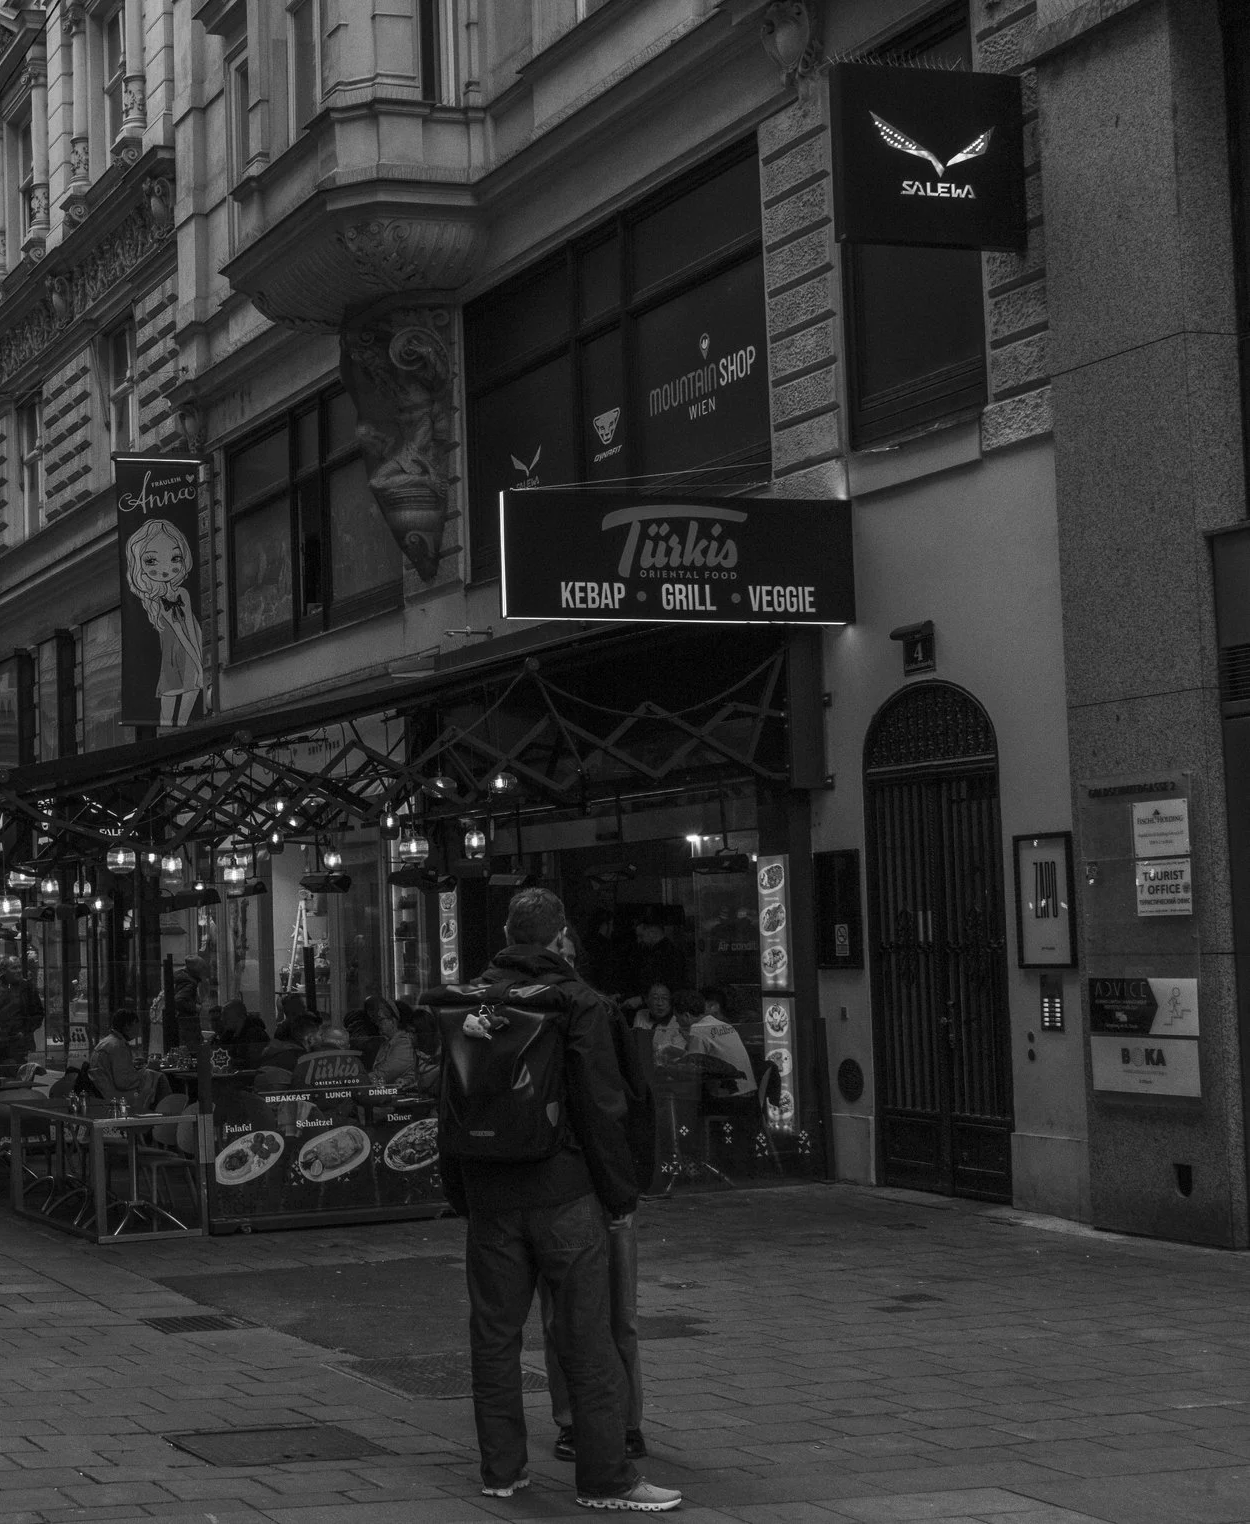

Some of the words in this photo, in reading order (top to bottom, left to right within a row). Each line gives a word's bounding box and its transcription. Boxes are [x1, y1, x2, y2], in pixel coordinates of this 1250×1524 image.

[900, 180, 977, 199] SALEWA
[649, 362, 717, 417] MOUNTAIN
[718, 345, 756, 387] SHOP
[688, 396, 716, 421] WIEN
[118, 470, 197, 514] Anna
[601, 504, 748, 578] Türkis
[639, 570, 700, 579] ORIENTAL
[704, 571, 738, 580] FOOD
[561, 581, 626, 609] KEBAP
[661, 583, 717, 611] GRILL
[748, 585, 817, 613] VEGGIE
[913, 641, 924, 661] 4
[1168, 781, 1176, 792] 2
[1142, 870, 1185, 882] TOURIST
[1147, 884, 1181, 895] OFFICE
[1094, 981, 1147, 998] ADVICE
[297, 1049, 363, 1085] Türkis
[265, 1093, 311, 1103] BREAKFAST
[325, 1091, 352, 1099] LUNCH
[368, 1088, 398, 1097] DINNER
[224, 1122, 253, 1134] Falafel
[295, 1118, 333, 1128] Schnitzel
[387, 1113, 412, 1122] Döner
